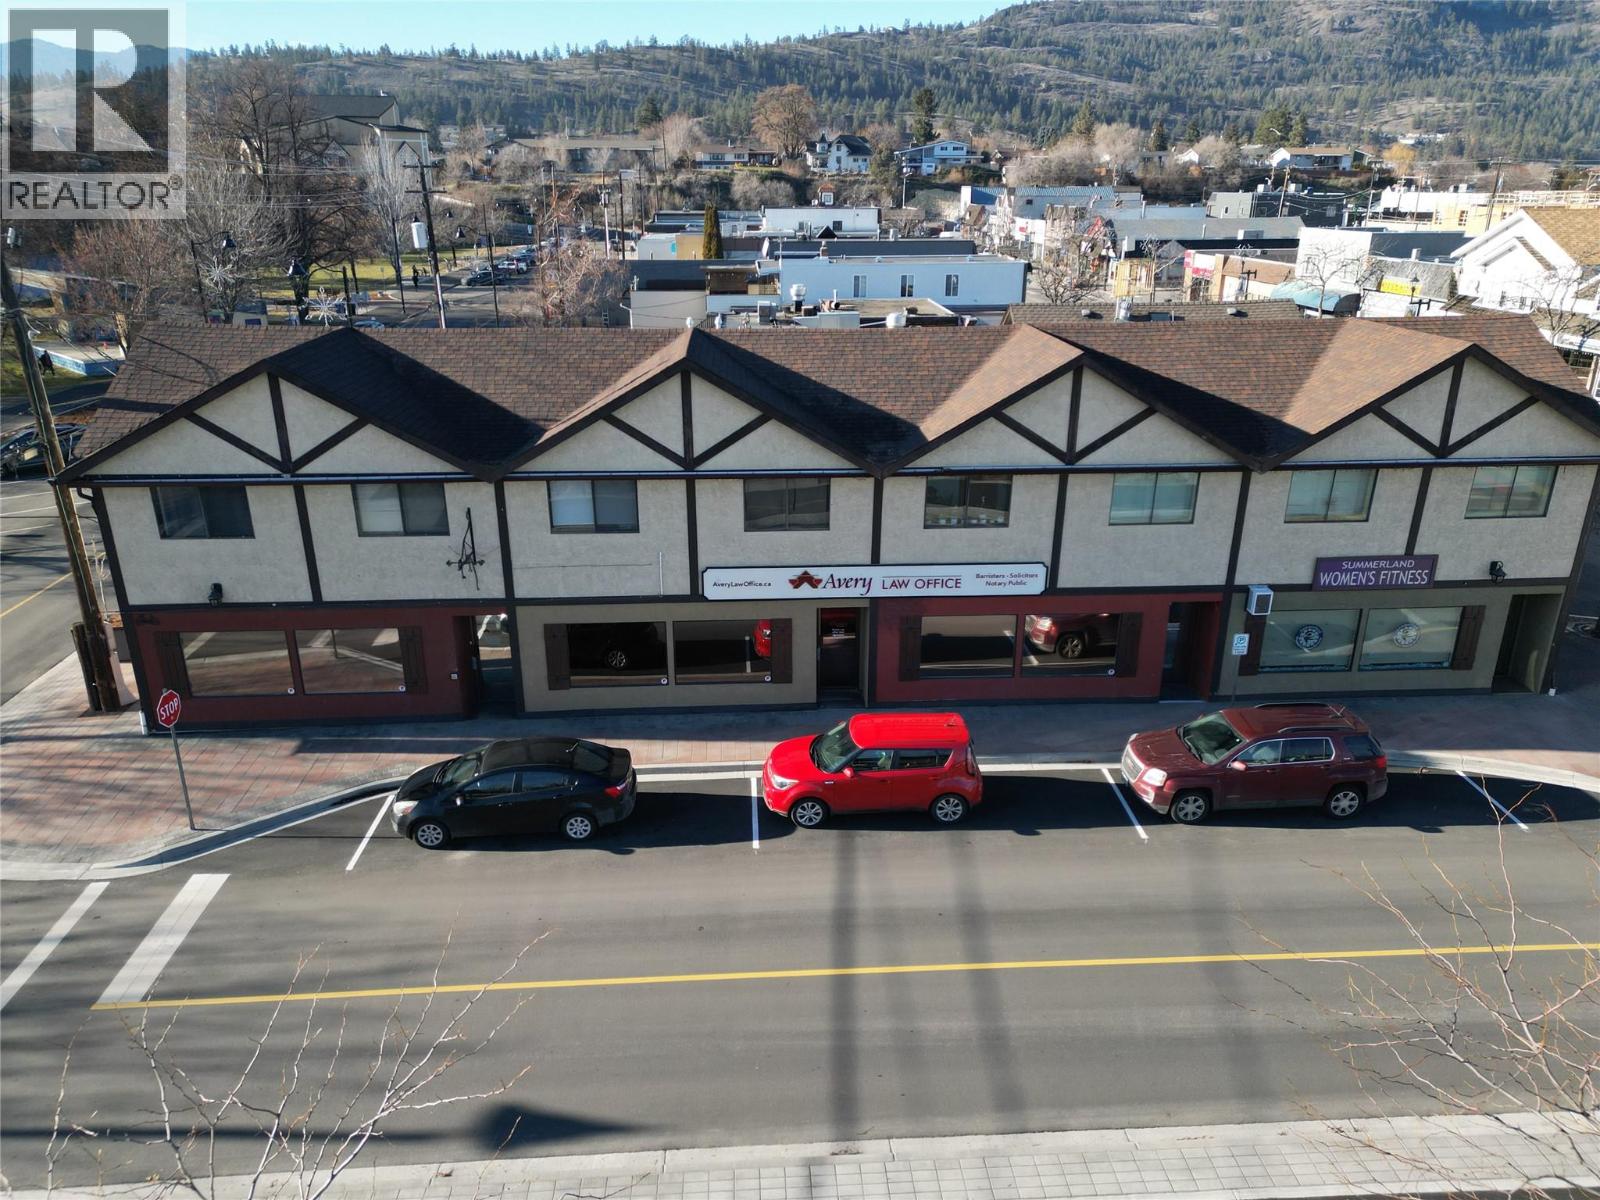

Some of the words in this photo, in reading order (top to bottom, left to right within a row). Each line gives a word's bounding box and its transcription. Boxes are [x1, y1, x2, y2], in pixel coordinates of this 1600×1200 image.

[1341, 559, 1415, 570] SUMMERLAND
[712, 580, 772, 588] AveryLawOffice.ca
[822, 573, 873, 596] Avery
[882, 579, 911, 590] LAW
[914, 577, 962, 589] OFFICE
[1320, 570, 1376, 586] WOMEN'S
[1378, 569, 1430, 585] FITNESS
[159, 697, 179, 720] STOP
